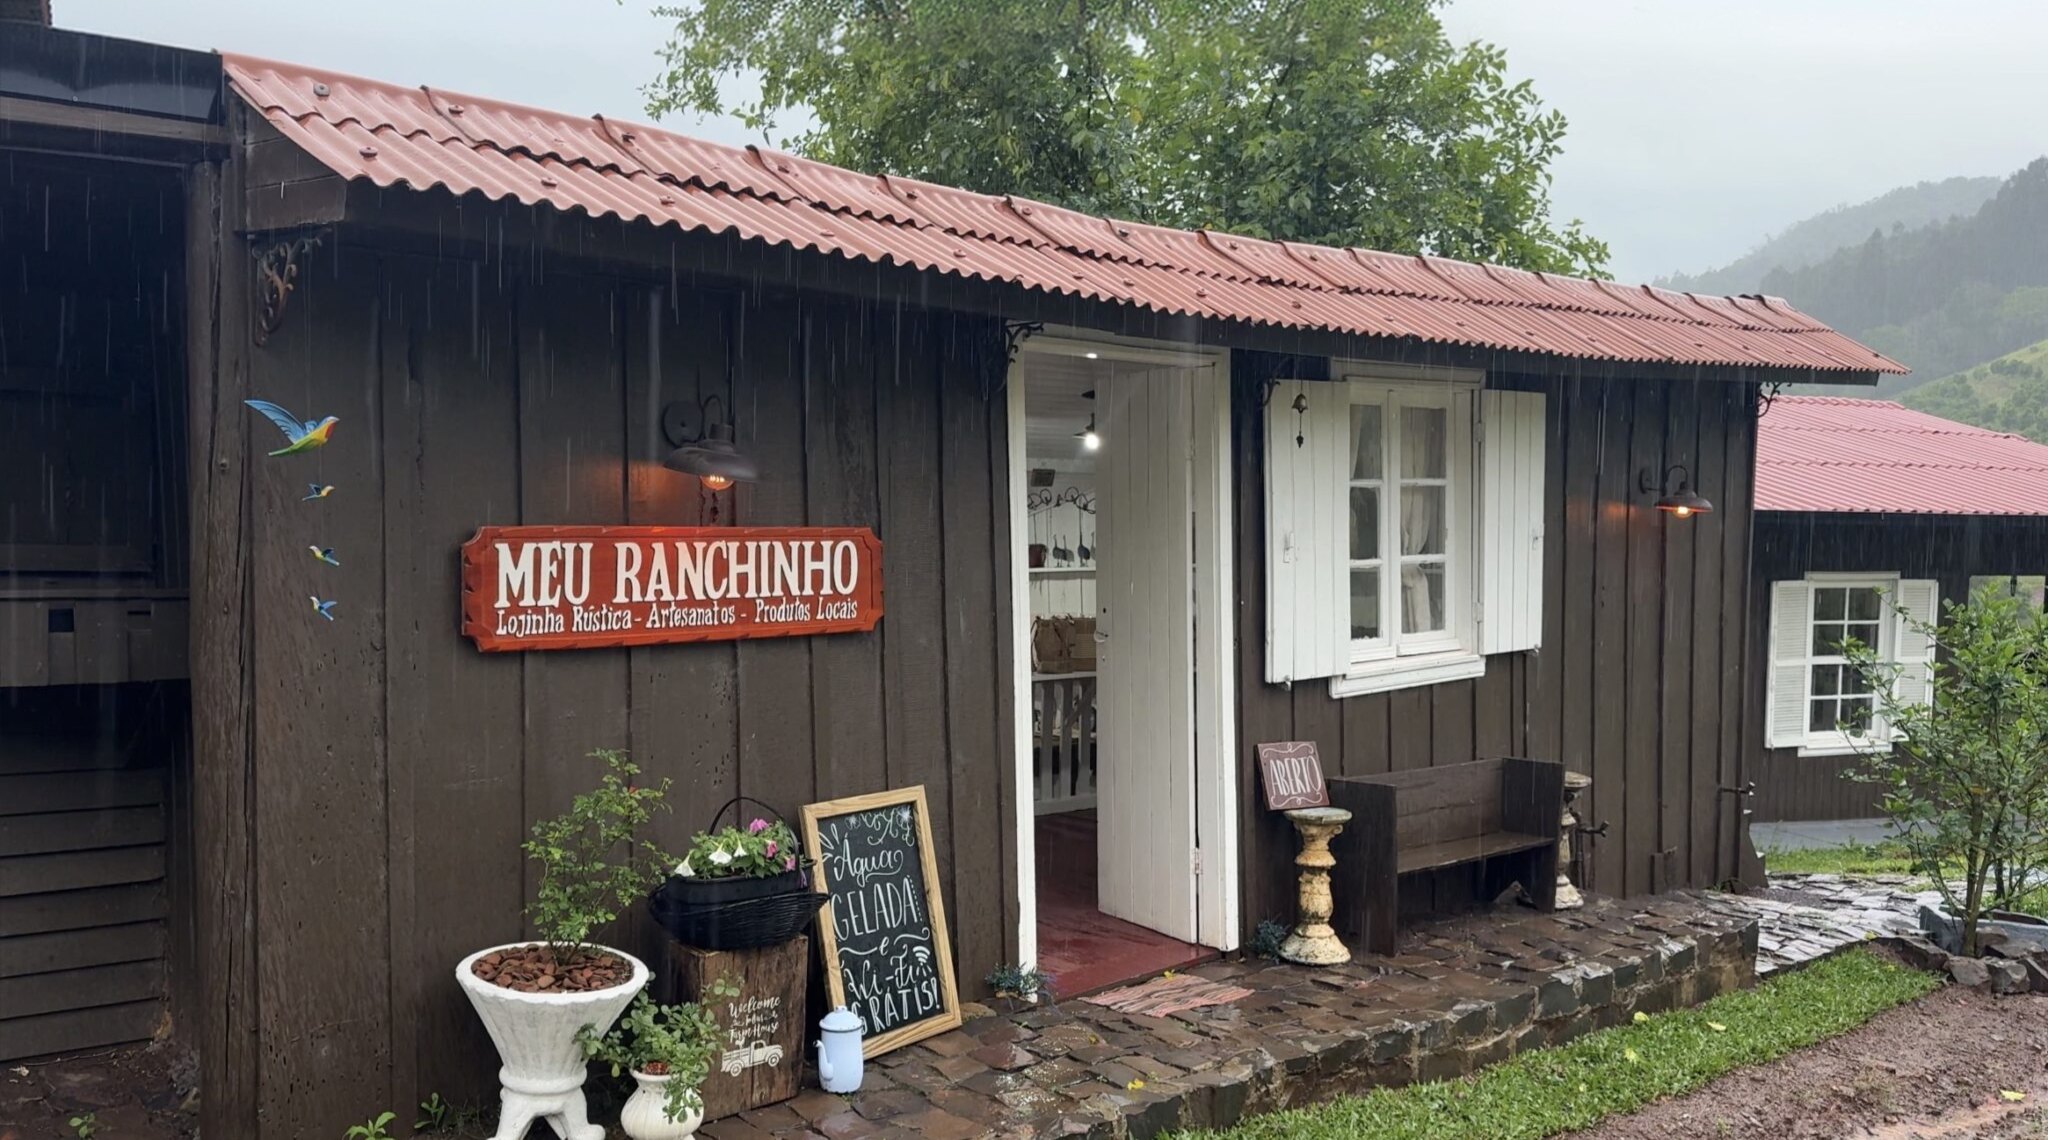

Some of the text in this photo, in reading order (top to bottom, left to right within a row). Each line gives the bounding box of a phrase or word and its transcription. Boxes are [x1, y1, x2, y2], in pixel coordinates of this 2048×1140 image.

[494, 540, 859, 608] MEU RANCHINHO
[495, 607, 565, 637] Lojinha
[645, 600, 736, 629] Artesanatos
[754, 596, 811, 623] Produtos
[816, 596, 858, 622] Locais
[1269, 755, 1322, 797] ABERTO
[833, 832, 896, 888] Água
[831, 876, 918, 941] GELADA
[879, 936, 890, 956] e
[728, 995, 781, 1018] Welcome
